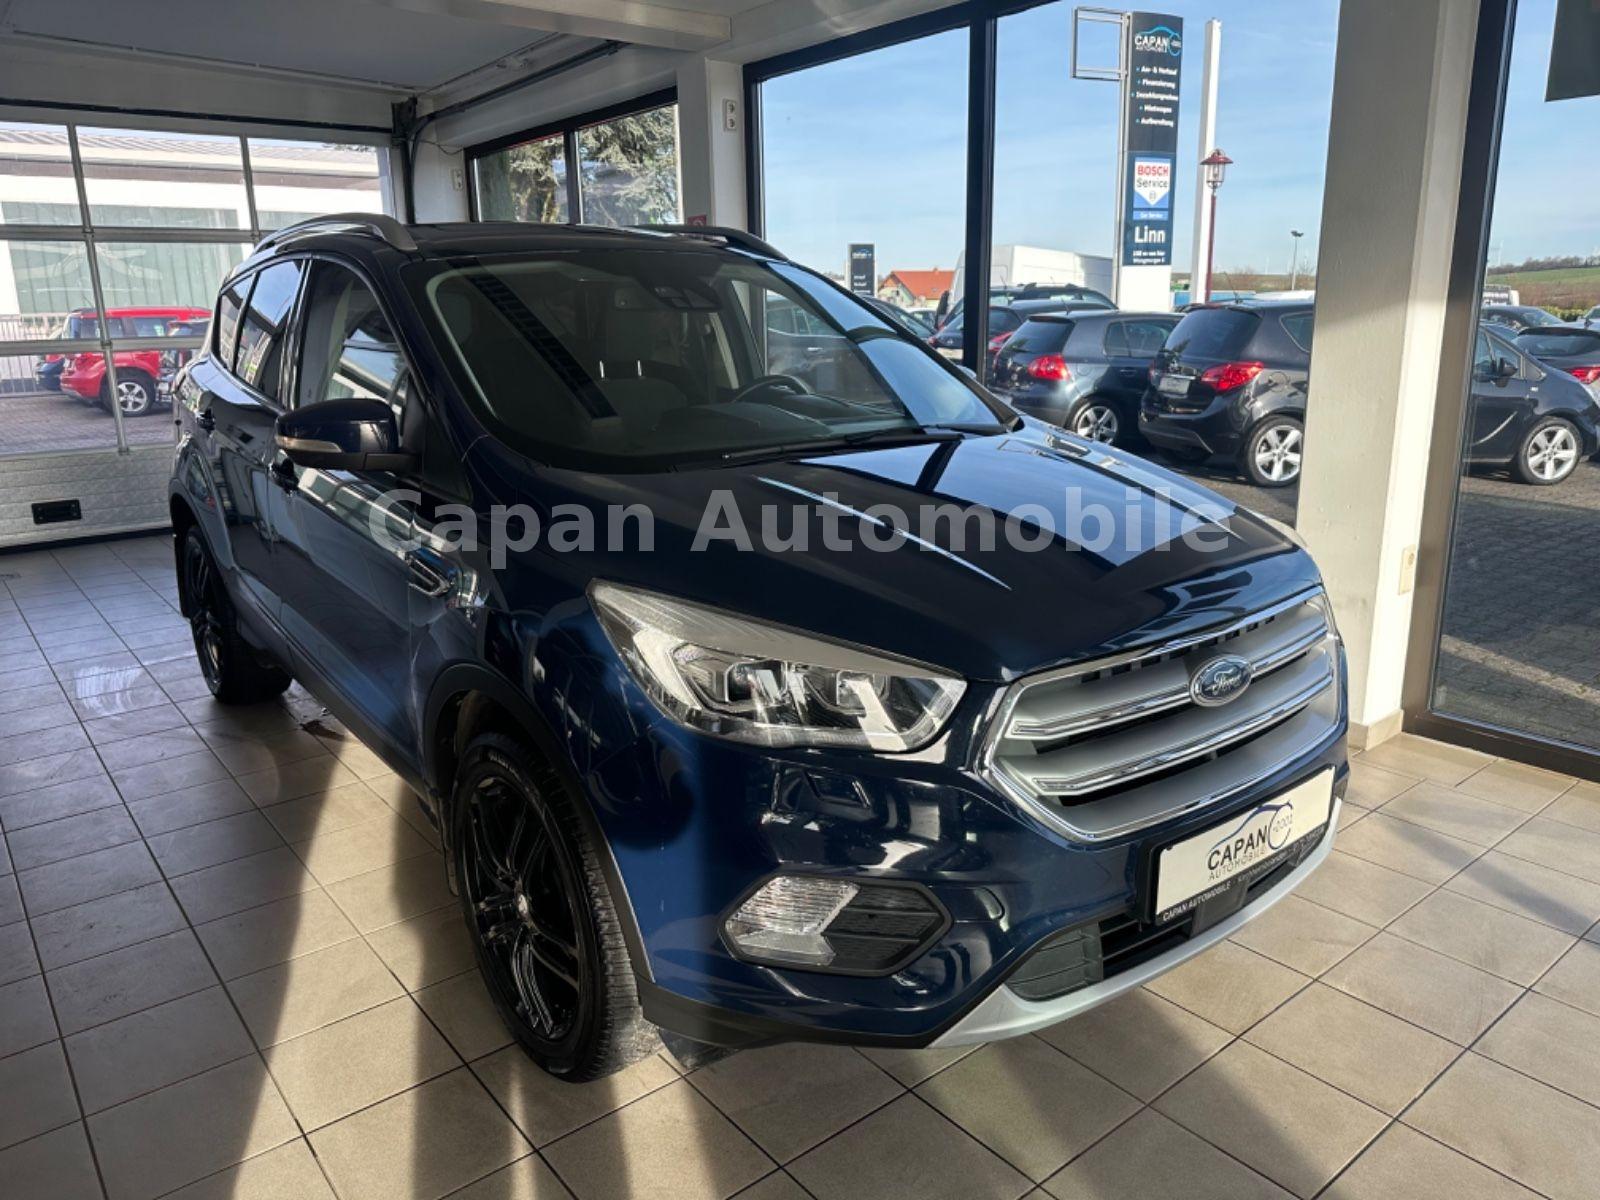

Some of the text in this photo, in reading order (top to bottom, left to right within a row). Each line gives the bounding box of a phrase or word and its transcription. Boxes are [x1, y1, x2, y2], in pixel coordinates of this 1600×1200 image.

[1135, 34, 1169, 47] CAPAN
[1137, 165, 1169, 176] BOSCH
[1136, 177, 1168, 188] Service
[1134, 225, 1166, 243] Linn
[1207, 825, 1267, 870] CAPAN
[1208, 848, 1267, 881] AUTOMOBILE
[1162, 902, 1189, 922] CAPAN
[1188, 880, 1232, 908] AUTOMOBILE
